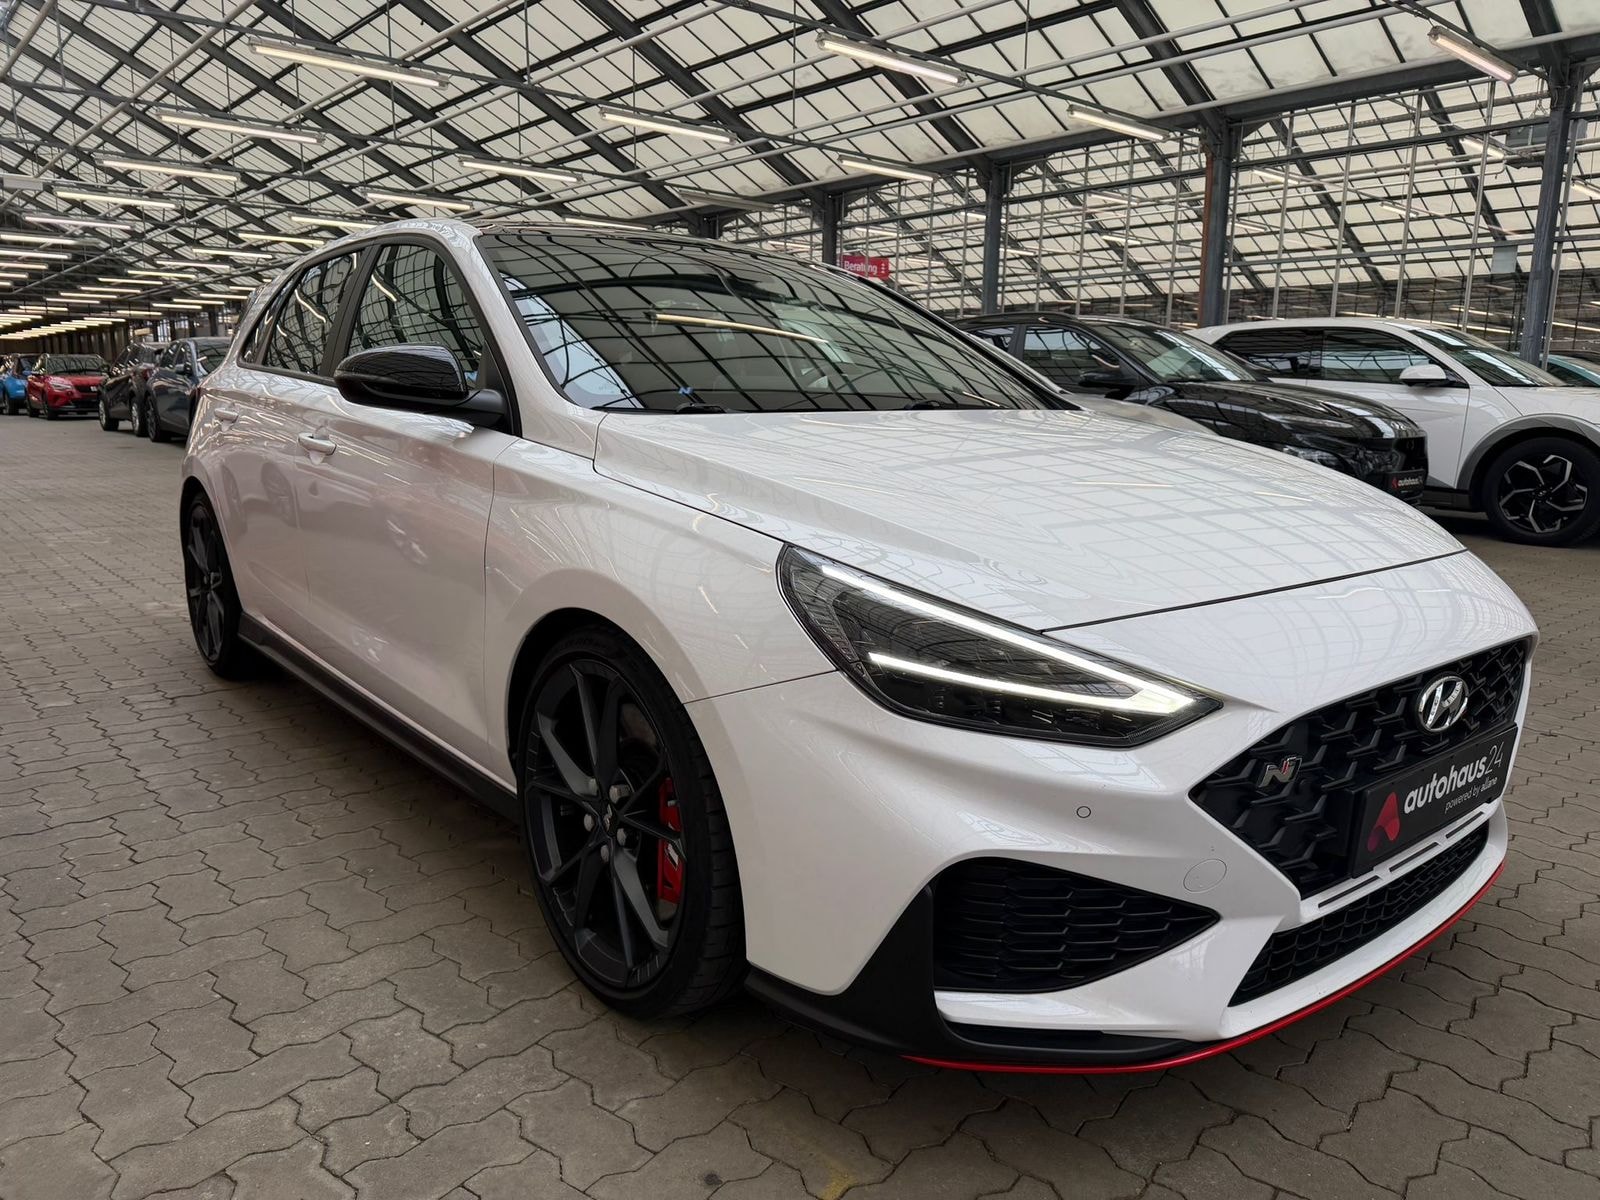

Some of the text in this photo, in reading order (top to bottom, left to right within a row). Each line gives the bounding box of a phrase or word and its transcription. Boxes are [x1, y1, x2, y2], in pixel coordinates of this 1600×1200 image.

[1404, 742, 1504, 814] autohaus24
[1444, 786, 1473, 814] powered
[1472, 785, 1481, 798] by
